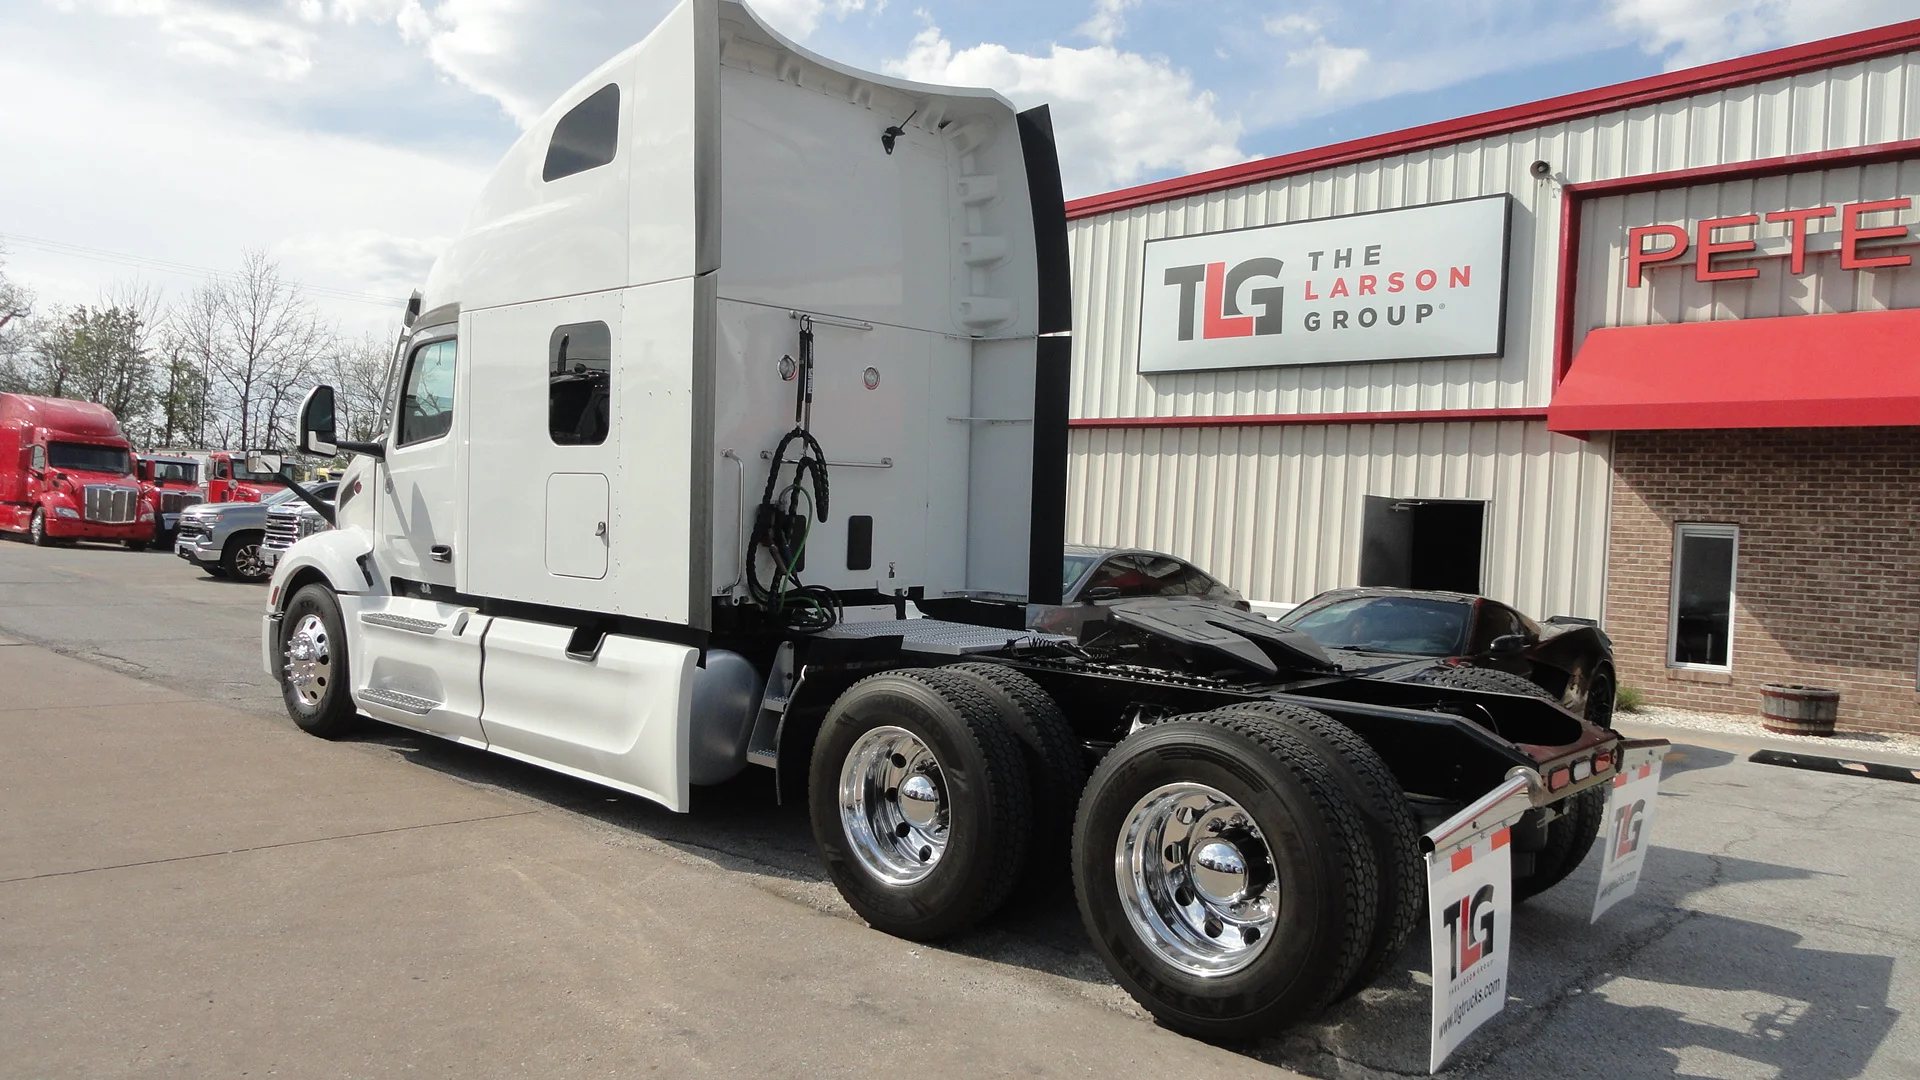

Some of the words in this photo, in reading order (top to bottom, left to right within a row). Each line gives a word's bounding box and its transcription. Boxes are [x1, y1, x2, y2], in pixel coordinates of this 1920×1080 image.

[1307, 244, 1382, 272] THE
[1626, 197, 1913, 289] PETE
[1163, 256, 1285, 342] TLG
[1304, 265, 1471, 301] LARSON
[1610, 798, 1646, 864] TLG
[1443, 883, 1495, 984] TLG
[1438, 977, 1501, 1040] www.tlgtrucks.com
